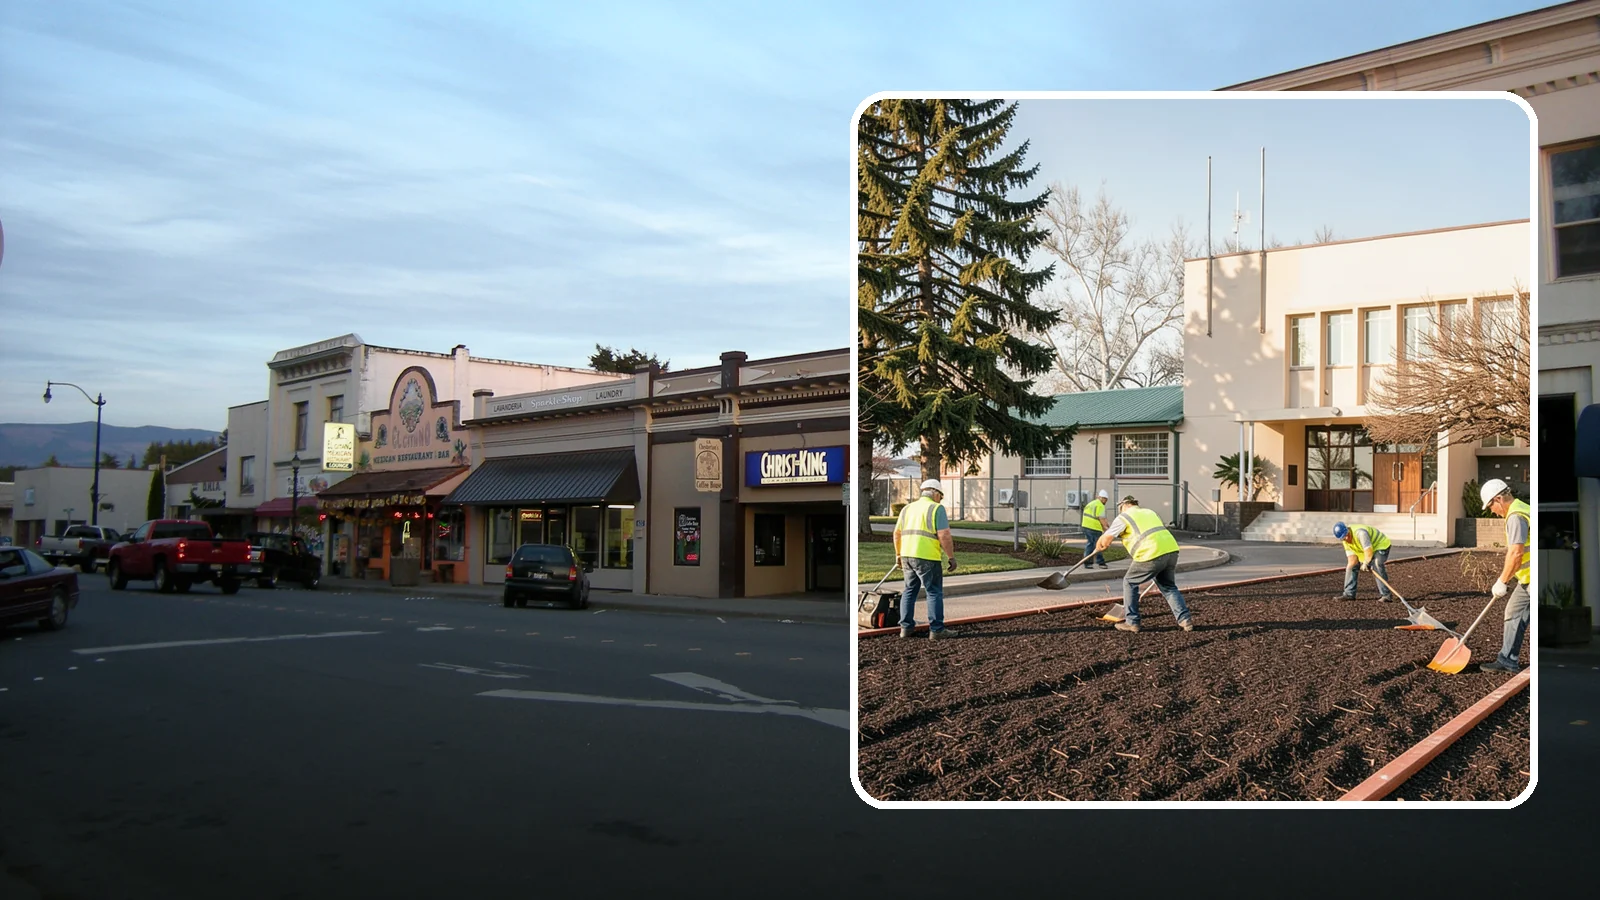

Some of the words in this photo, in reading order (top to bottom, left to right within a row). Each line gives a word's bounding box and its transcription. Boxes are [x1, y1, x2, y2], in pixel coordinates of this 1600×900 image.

[493, 402, 523, 413] LAVANDERIA
[530, 395, 561, 409] Sparkle
[561, 393, 582, 406] Shop
[595, 389, 624, 400] LAUNDRY
[373, 454, 396, 464] MEXICAN
[397, 451, 433, 462] RESTAURANT
[438, 450, 450, 459] BAR
[760, 452, 797, 478] CHRIST
[799, 450, 827, 476] KING
